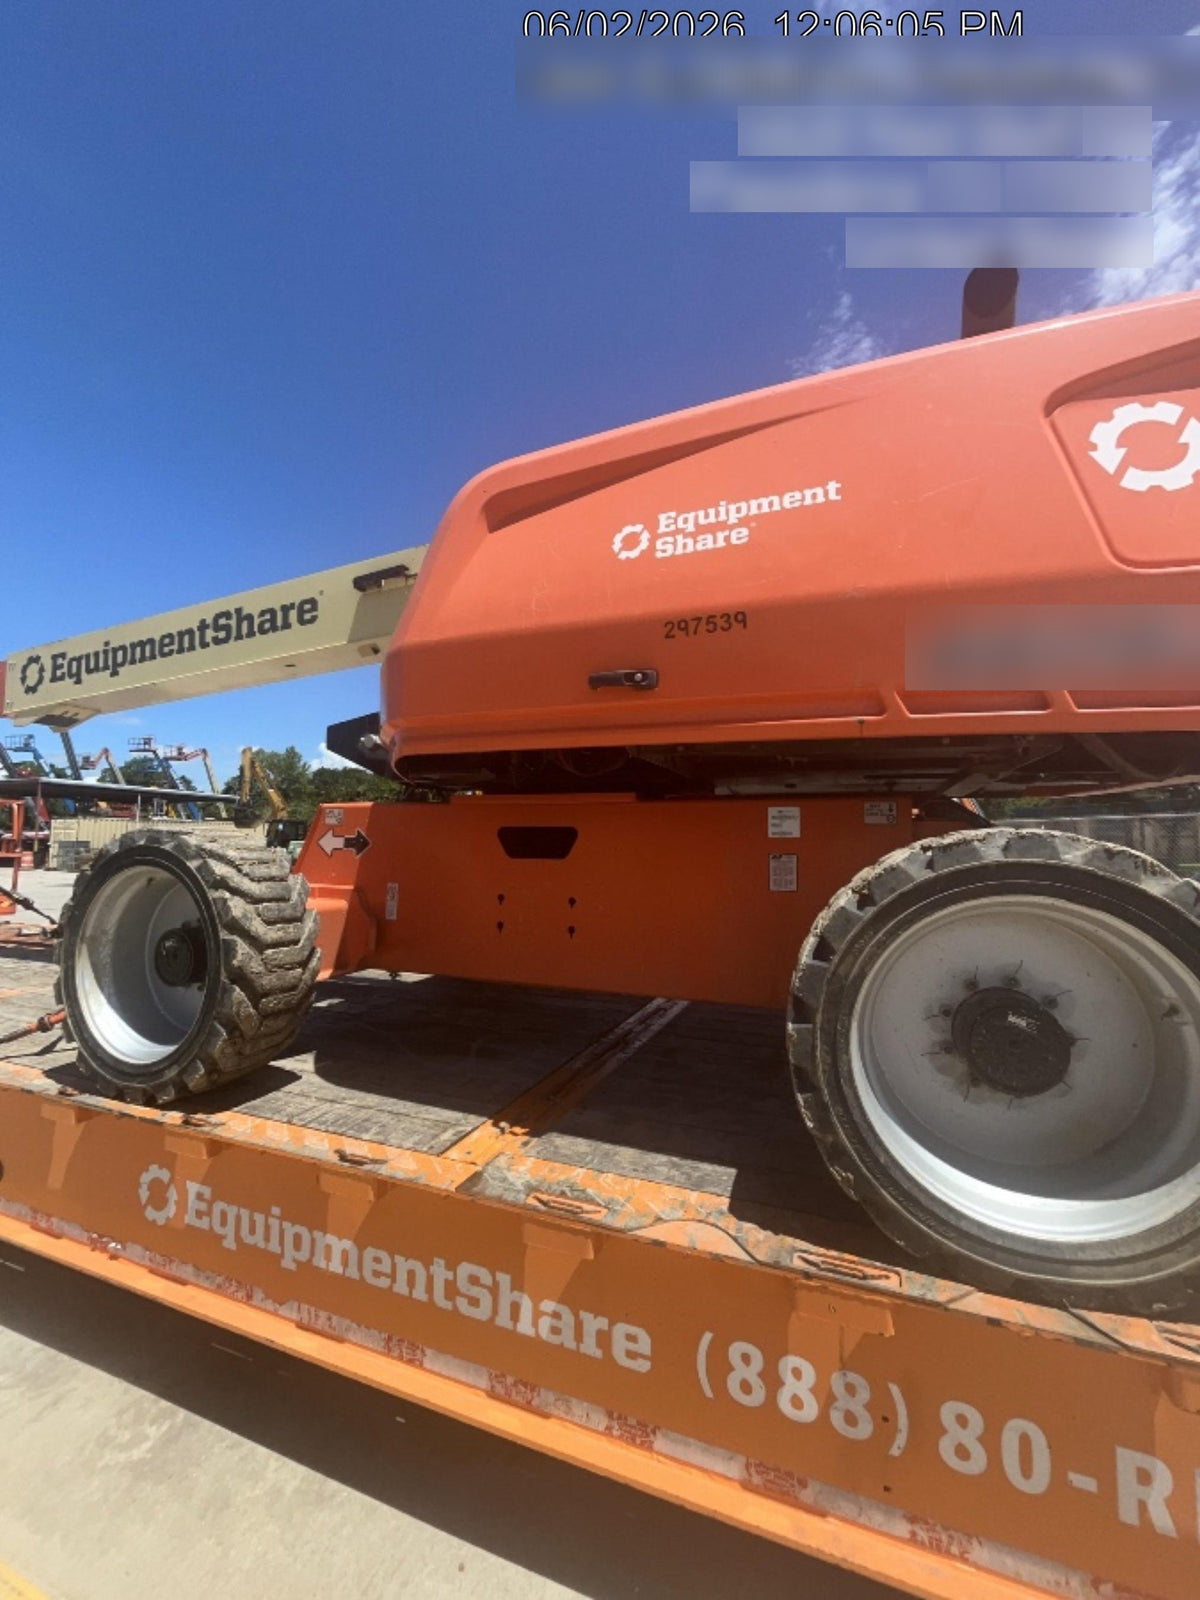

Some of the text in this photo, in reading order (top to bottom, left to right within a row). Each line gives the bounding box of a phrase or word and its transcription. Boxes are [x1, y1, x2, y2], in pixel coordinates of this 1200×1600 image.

[657, 480, 842, 533] Equipment
[655, 526, 750, 559] Share
[49, 596, 319, 685] EquipmentShare
[663, 610, 748, 640] 297539
[183, 1179, 1200, 1545] EquipmentShare (888) 80-R
